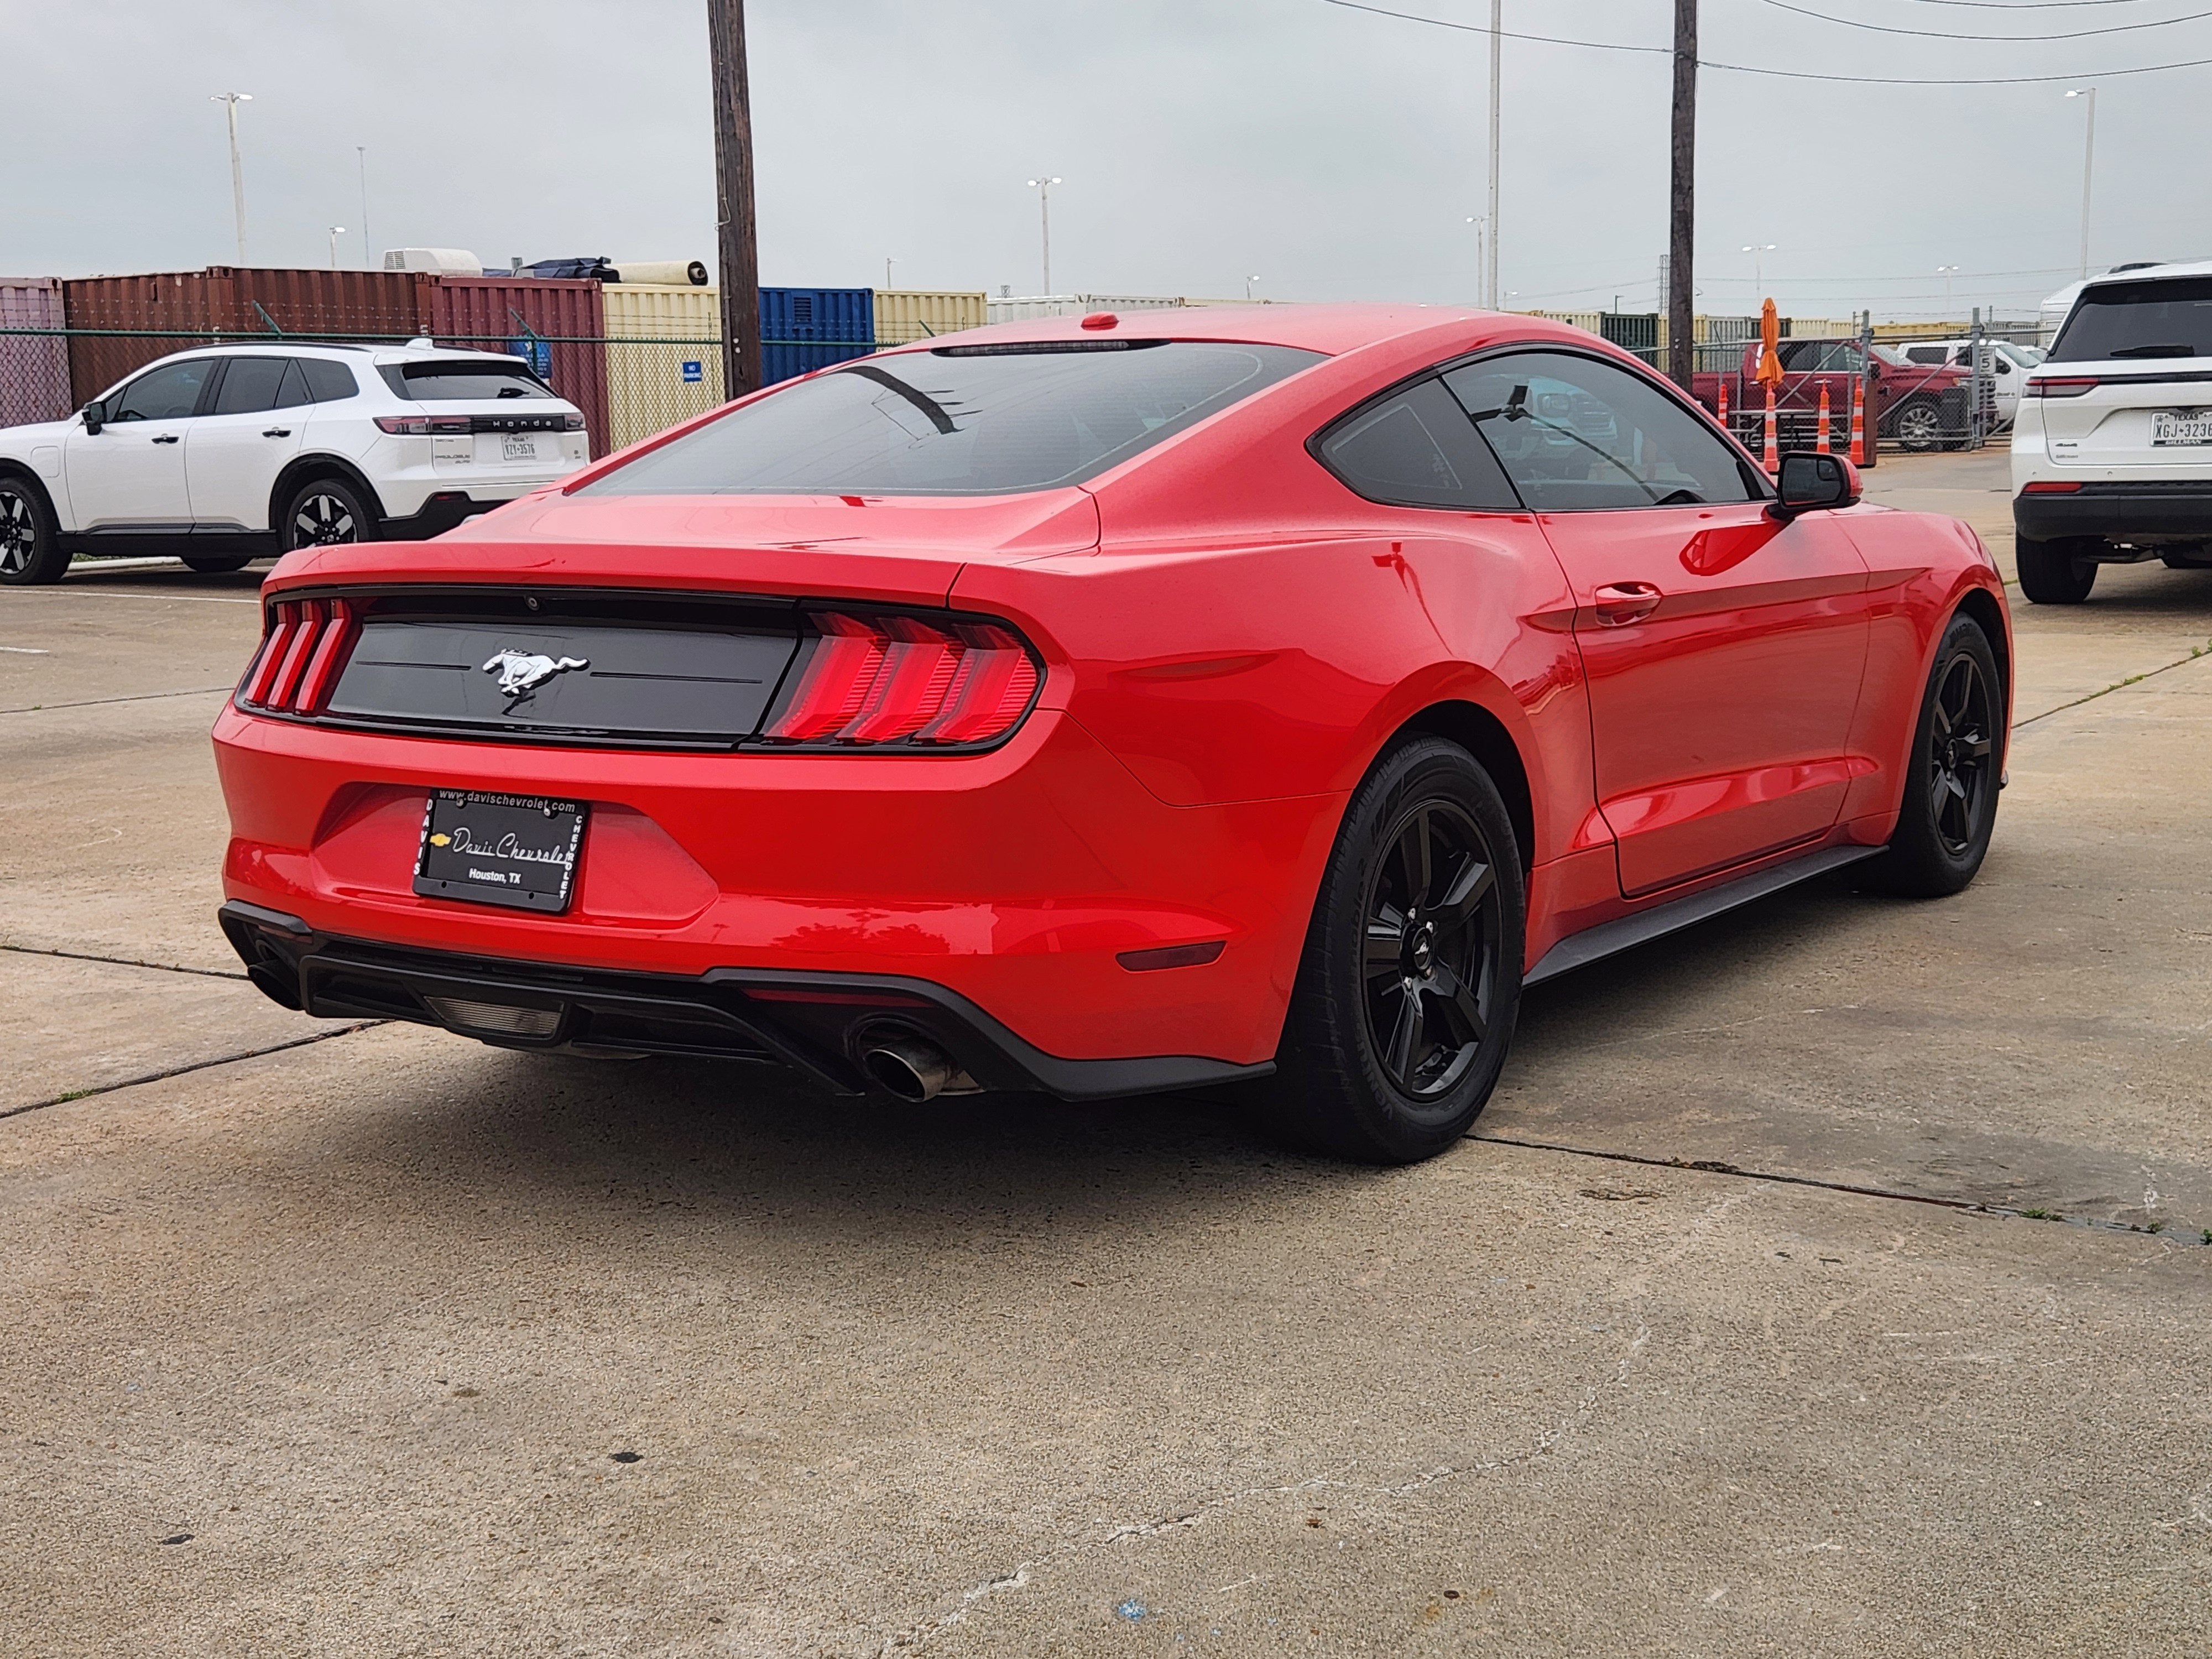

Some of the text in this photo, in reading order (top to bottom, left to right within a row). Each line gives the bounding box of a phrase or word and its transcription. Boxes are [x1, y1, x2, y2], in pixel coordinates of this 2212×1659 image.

[1981, 358, 1990, 368] 5
[2174, 413, 2199, 421] TEXAS
[439, 789, 576, 813] www.davischevrolet.com
[413, 799, 433, 875] DAVIS
[452, 827, 495, 856] Davis
[559, 815, 583, 900] CHEVROLET
[469, 868, 522, 884] Houston, TX
